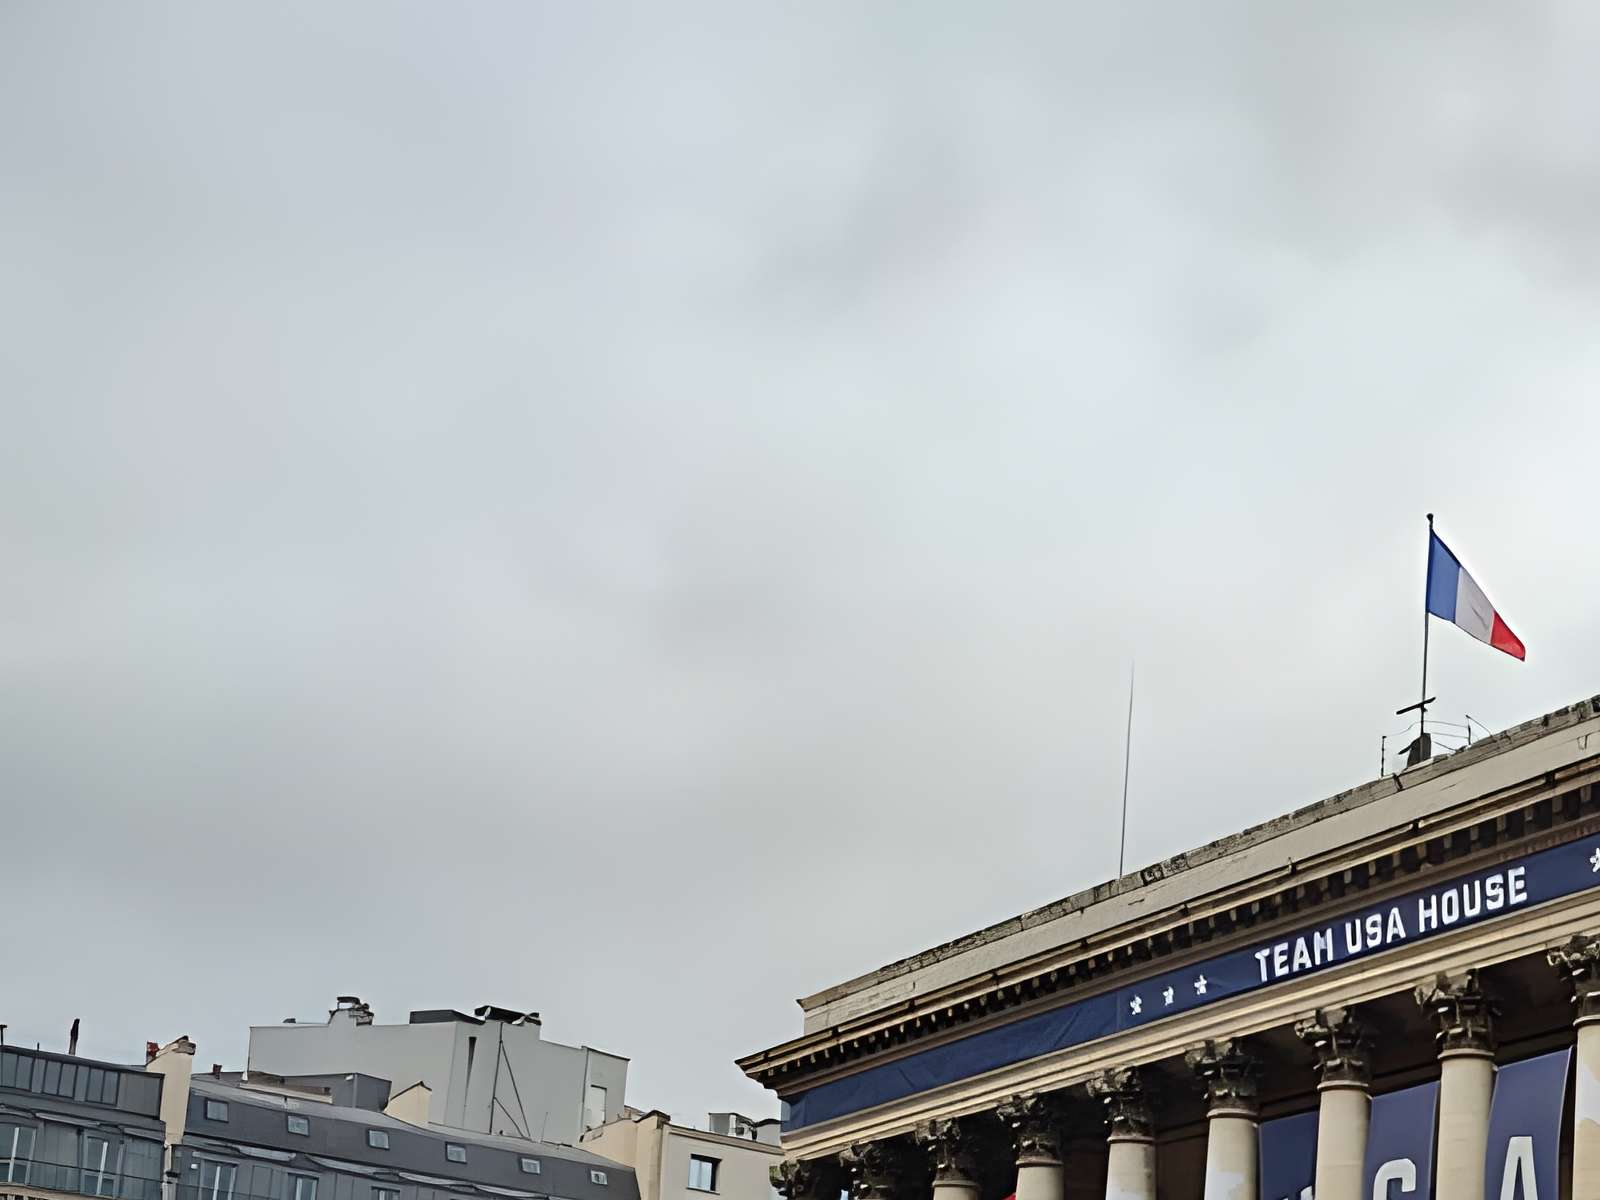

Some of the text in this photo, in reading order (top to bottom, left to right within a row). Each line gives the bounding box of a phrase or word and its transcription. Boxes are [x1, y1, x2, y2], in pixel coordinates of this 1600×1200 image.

[1254, 866, 1527, 982] TEAM USA HOUSE
